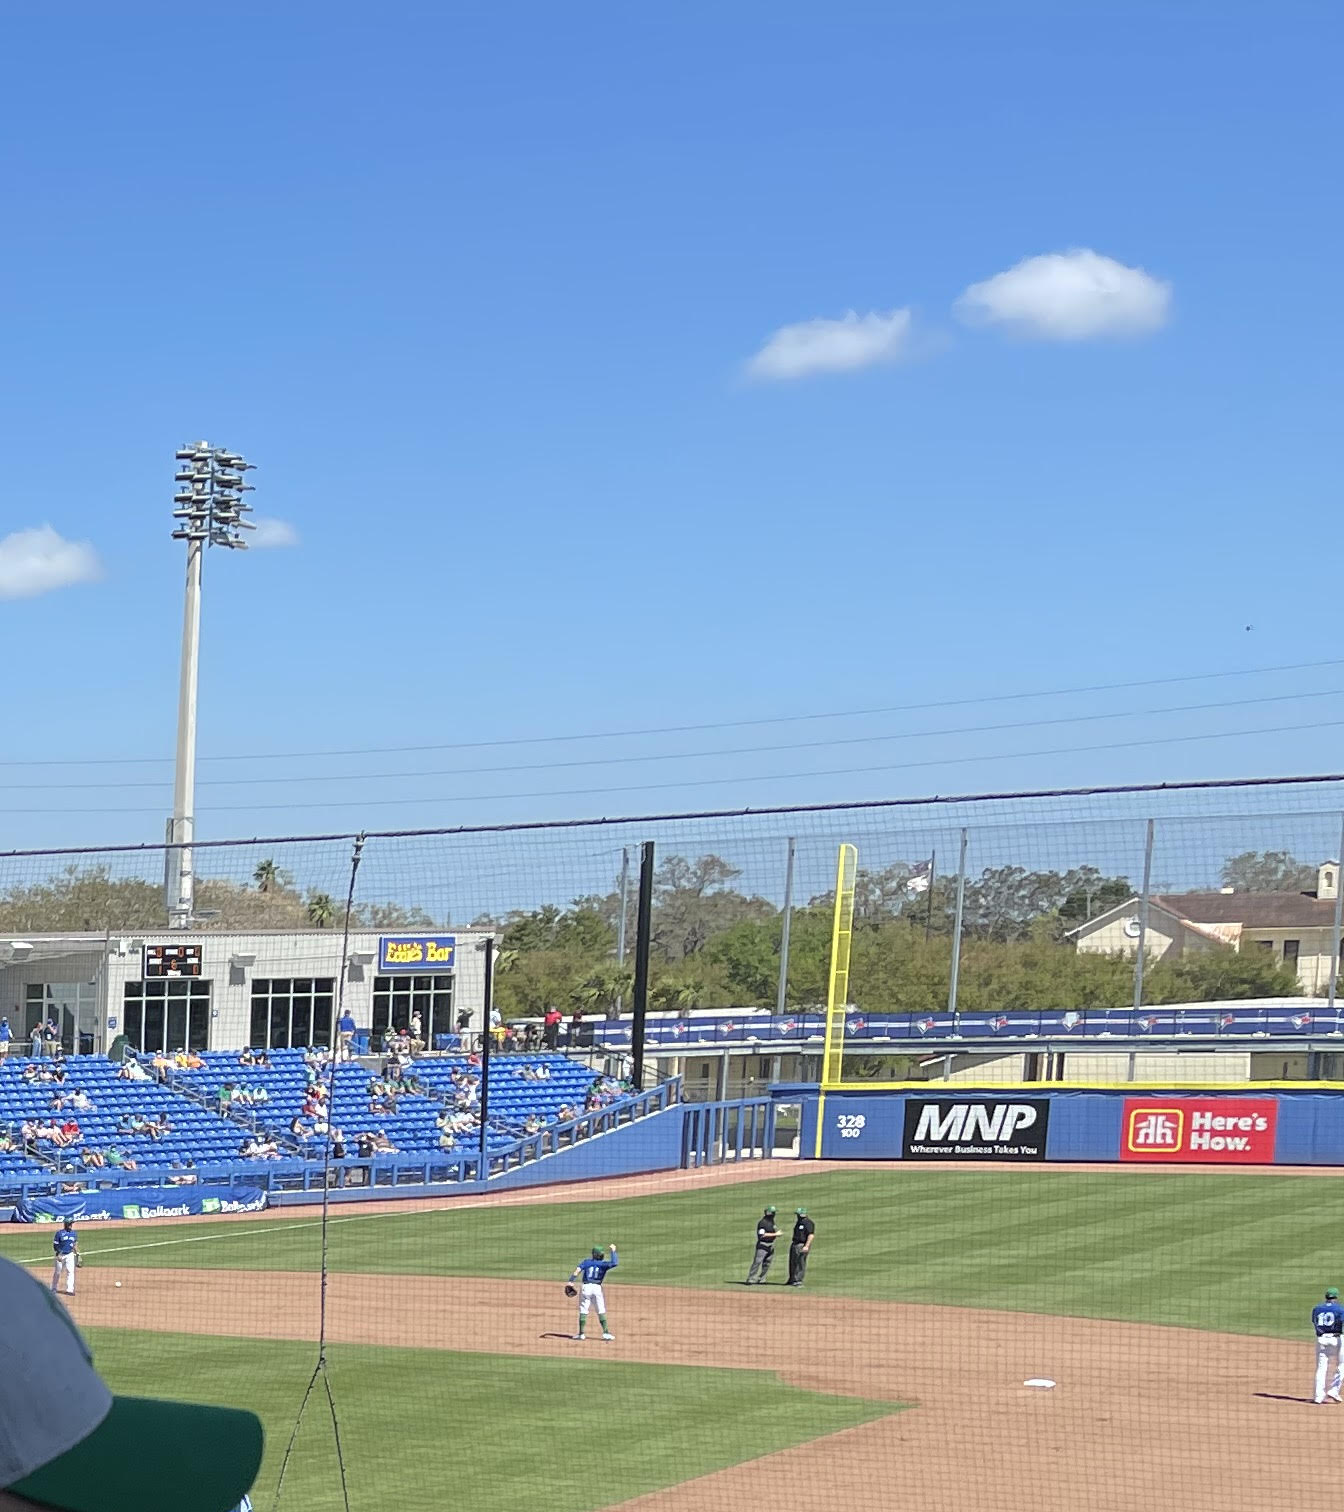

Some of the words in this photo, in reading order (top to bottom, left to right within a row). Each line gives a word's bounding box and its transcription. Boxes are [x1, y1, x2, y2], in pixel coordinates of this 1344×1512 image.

[425, 941, 453, 962] Bar
[836, 1115, 866, 1129] 328
[913, 1104, 1037, 1142] MNP
[1192, 1111, 1268, 1131] Here's
[911, 1145, 953, 1154] Wherever
[954, 1145, 993, 1154] Business
[994, 1145, 1019, 1154] Takes
[1020, 1146, 1038, 1155] You
[1190, 1132, 1252, 1151] How.
[141, 1204, 190, 1219] Ballpark
[1317, 1311, 1335, 1327] 10
